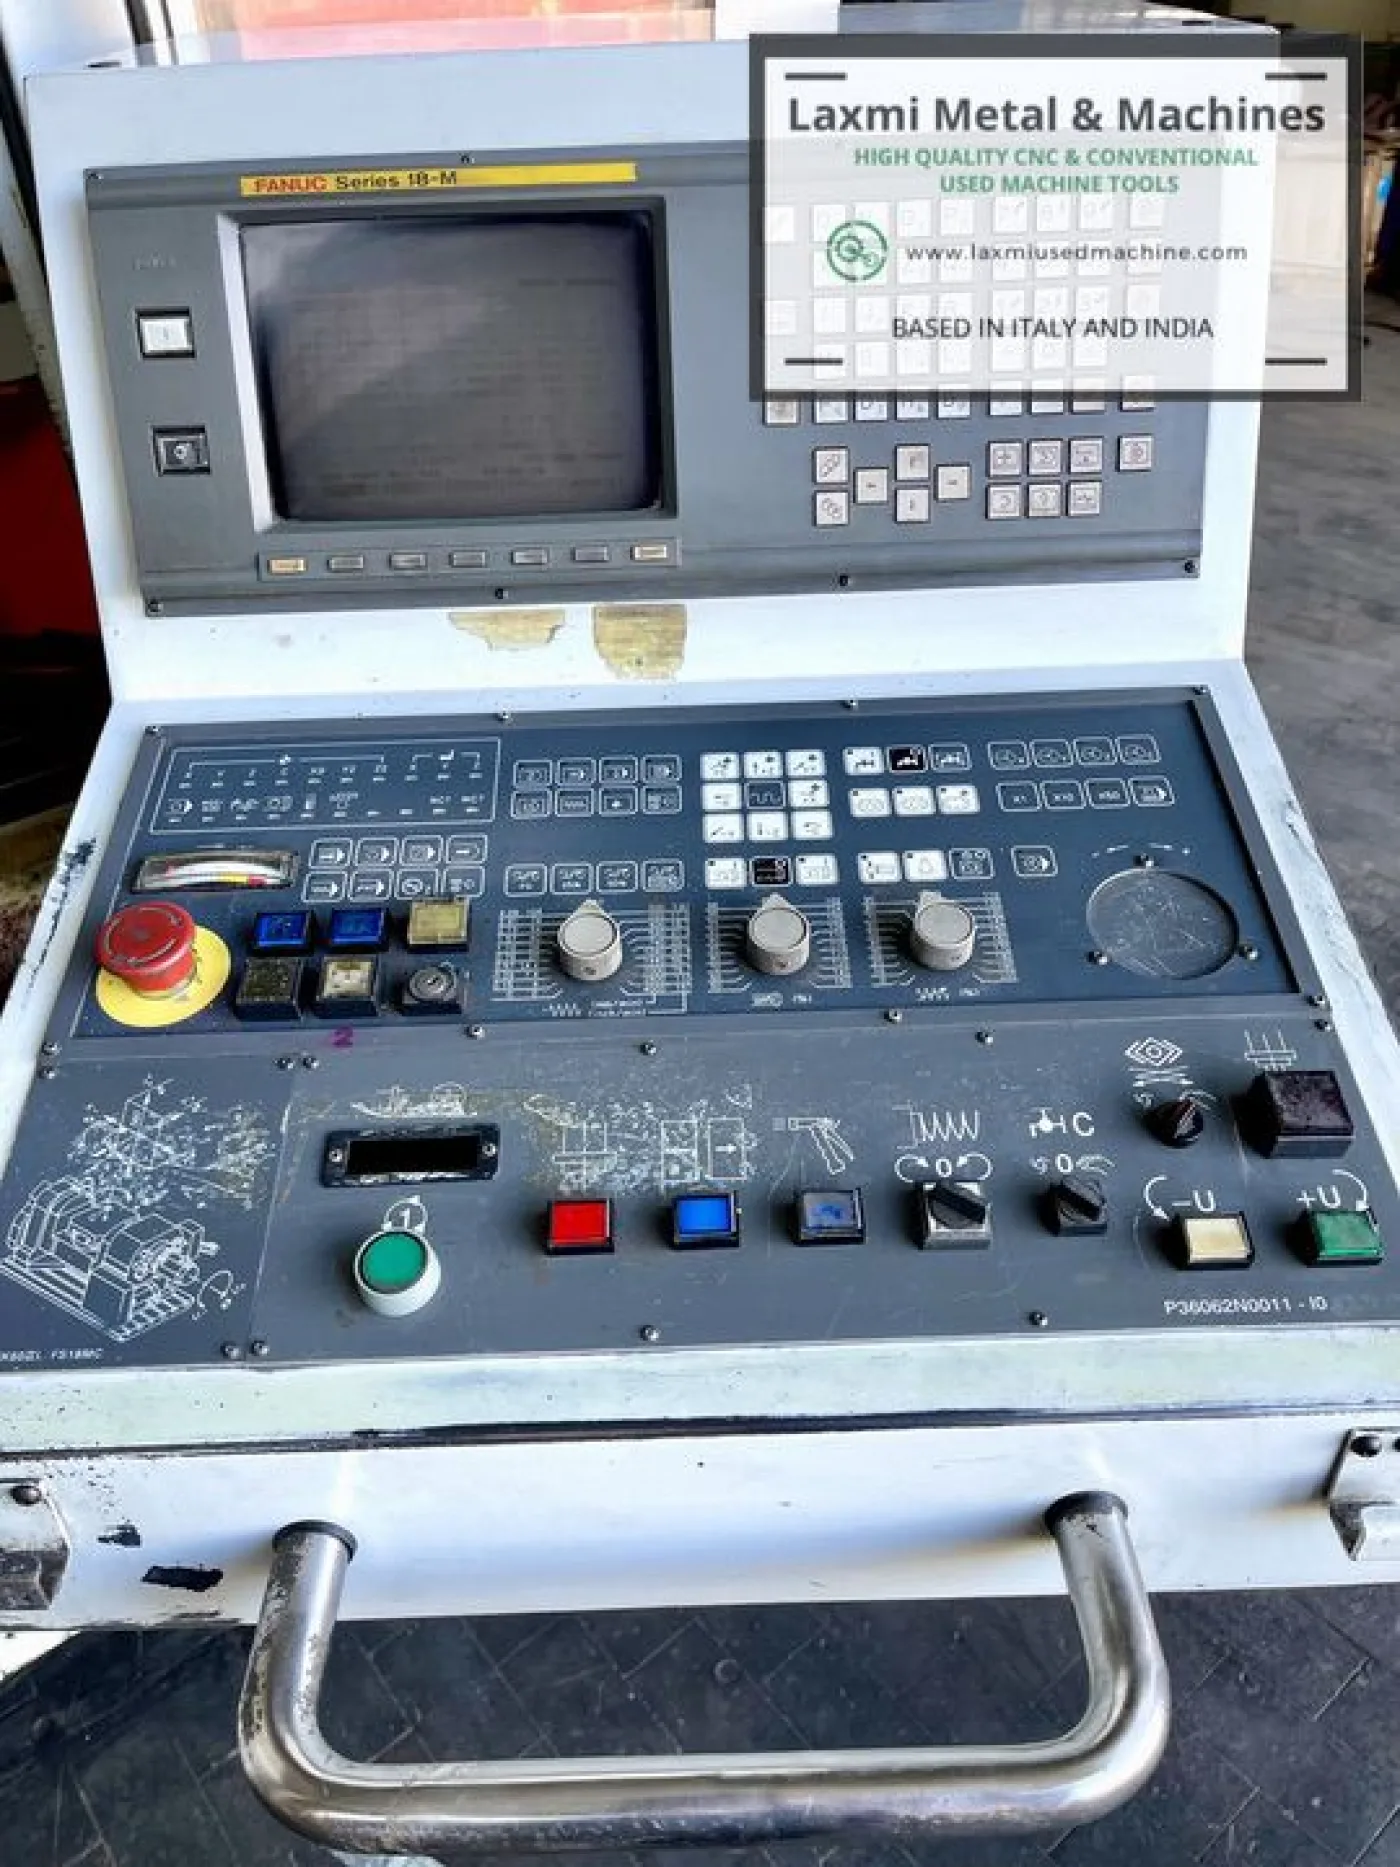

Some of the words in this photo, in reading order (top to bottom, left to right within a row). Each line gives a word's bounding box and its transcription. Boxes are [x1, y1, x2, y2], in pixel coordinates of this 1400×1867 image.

[254, 175, 328, 194] FANUC
[335, 173, 400, 190] Series
[331, 1026, 354, 1048] 2
[1072, 1111, 1095, 1136] C
